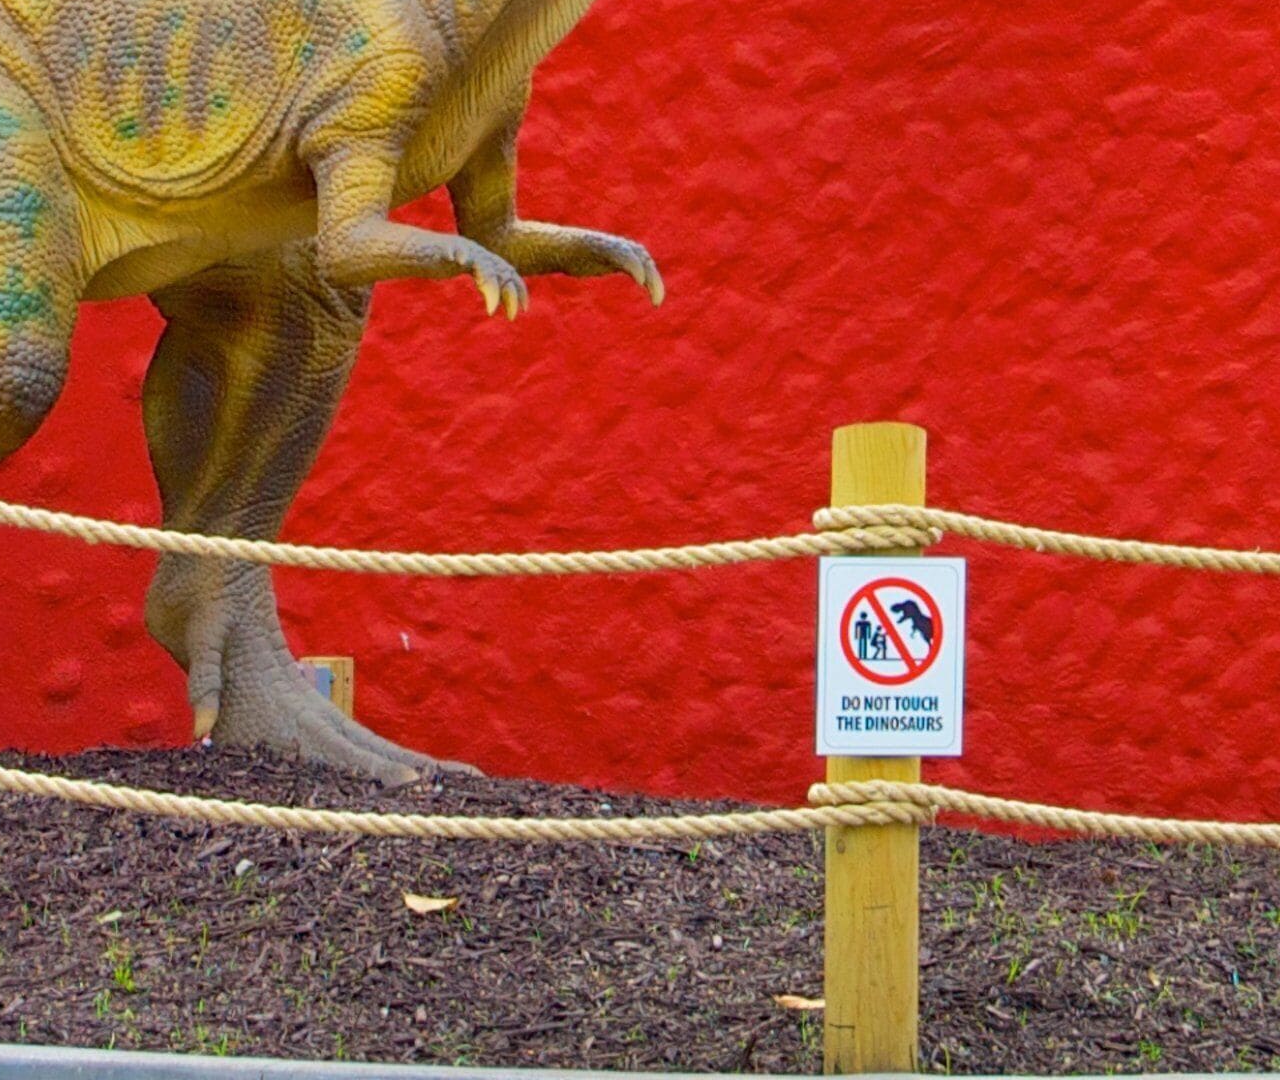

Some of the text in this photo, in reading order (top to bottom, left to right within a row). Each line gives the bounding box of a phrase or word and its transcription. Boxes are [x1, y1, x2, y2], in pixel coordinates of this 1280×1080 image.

[841, 696, 939, 711] DO NOT TOUCH
[836, 716, 943, 731] THE DINOSAURS
